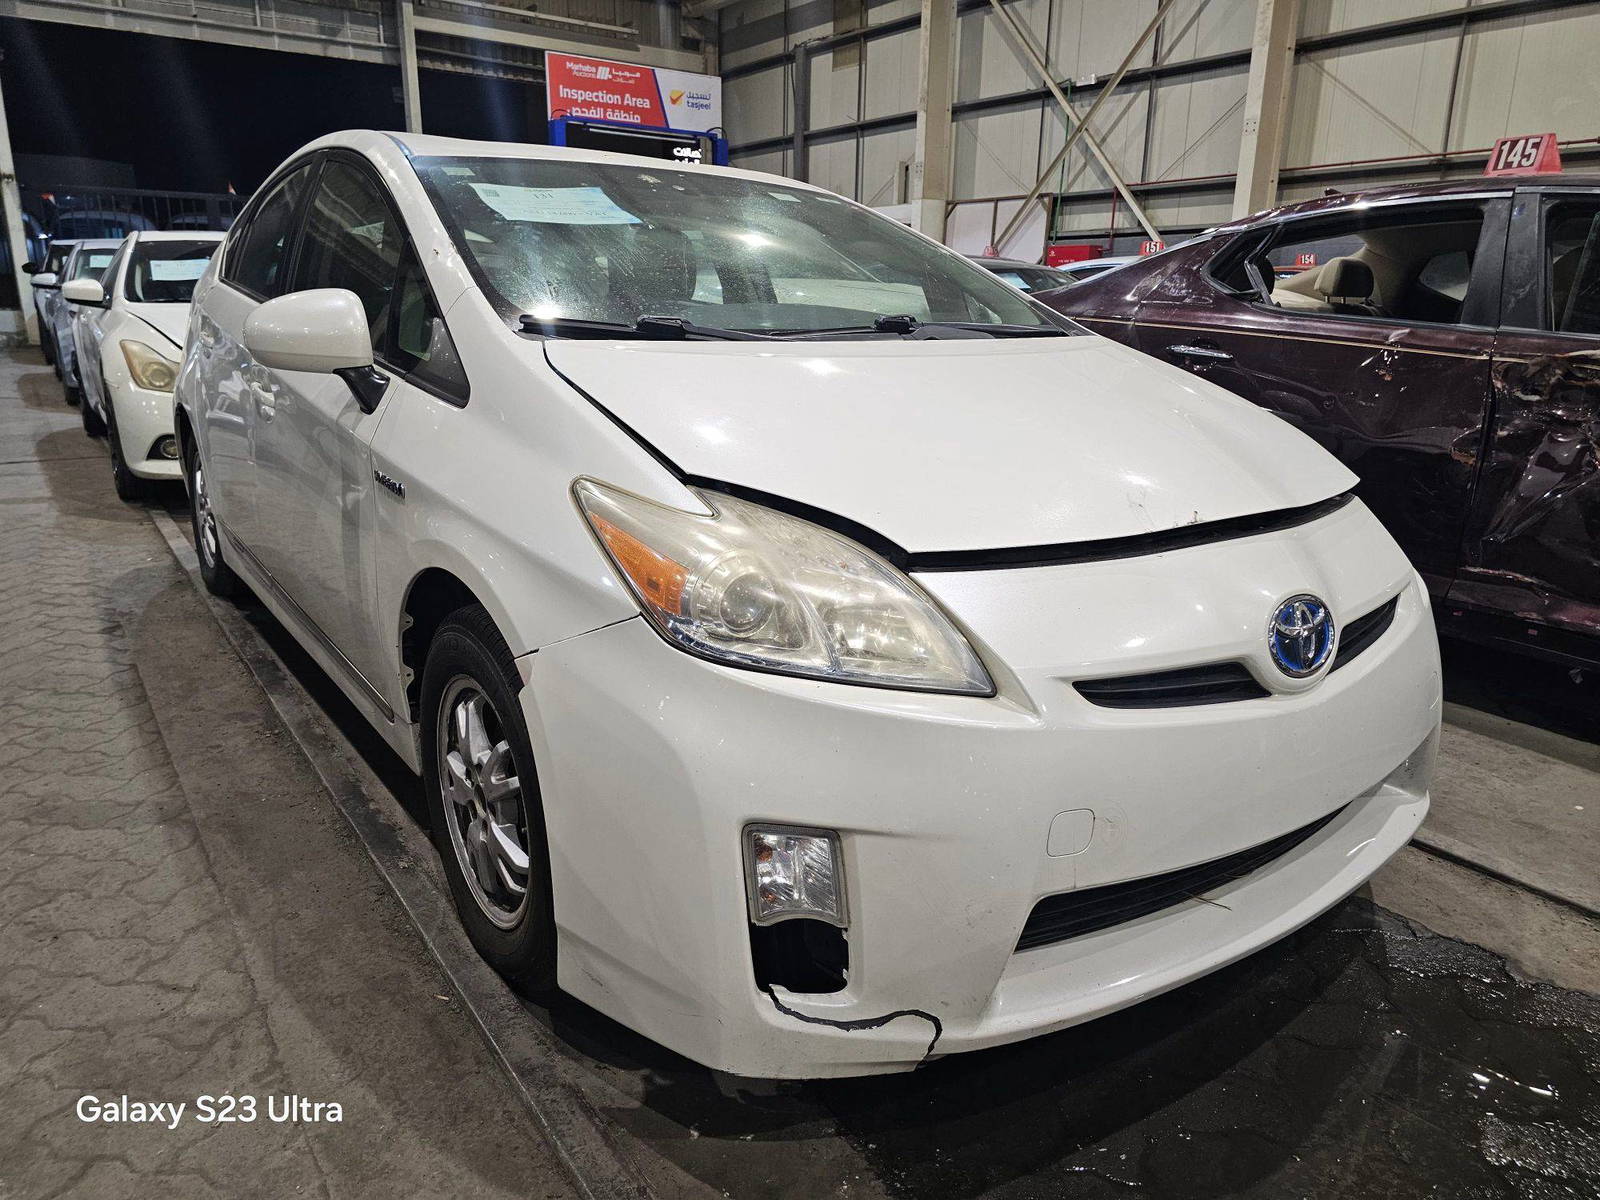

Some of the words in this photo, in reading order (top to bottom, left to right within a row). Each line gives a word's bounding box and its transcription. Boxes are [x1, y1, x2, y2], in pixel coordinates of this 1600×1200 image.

[566, 61, 596, 73] Marhaba
[559, 84, 621, 105] Inspection
[623, 93, 651, 109] Area
[686, 100, 711, 110] tasjeel
[606, 108, 641, 123] منطقة
[1497, 137, 1542, 170] 145
[1145, 241, 1161, 253] 151
[1301, 254, 1314, 264] 154
